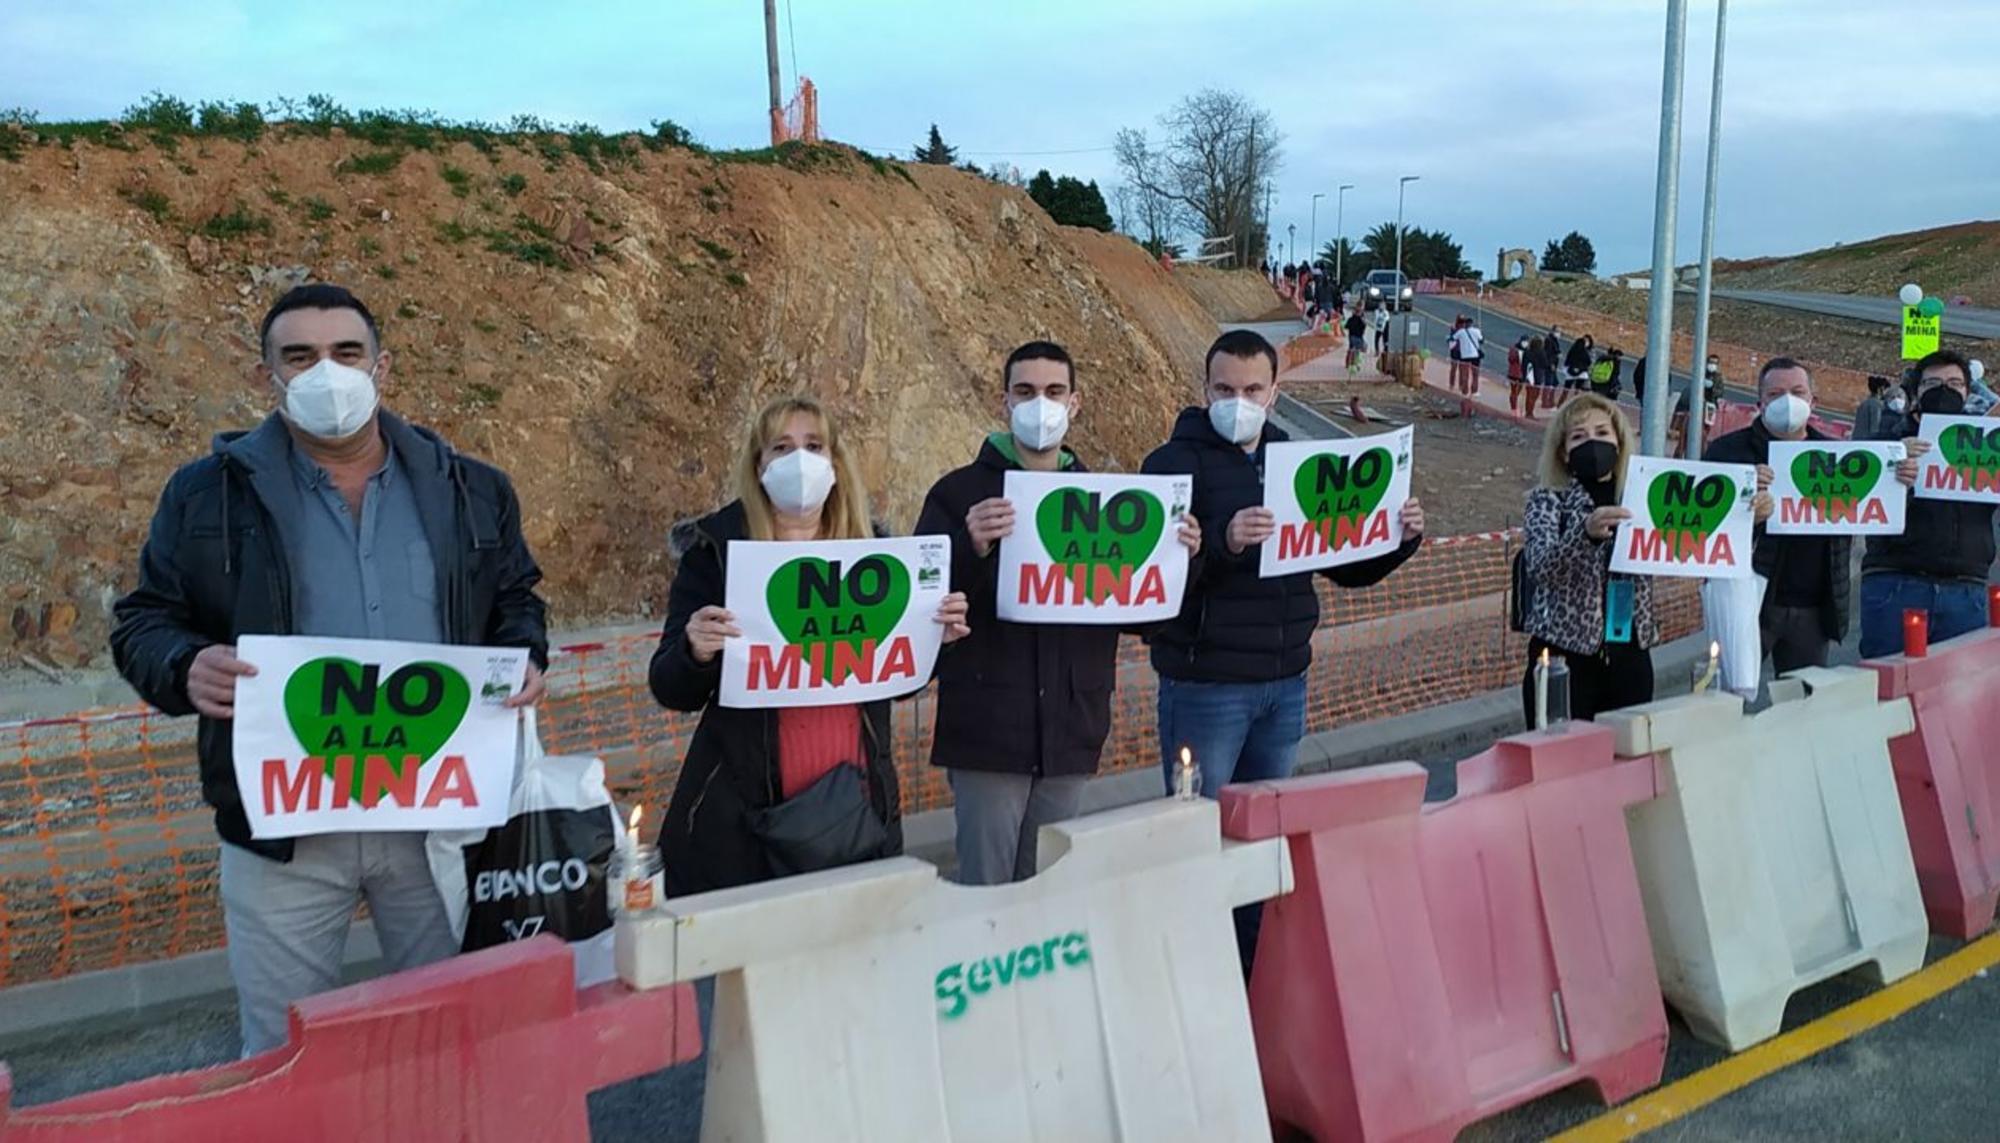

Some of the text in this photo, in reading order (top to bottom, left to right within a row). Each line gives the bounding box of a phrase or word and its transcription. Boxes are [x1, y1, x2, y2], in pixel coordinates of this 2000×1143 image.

[1905, 325, 1936, 336] MINA
[1956, 425, 2000, 453] NO
[1315, 450, 1382, 495] NO
[1808, 450, 1869, 479] NO
[1925, 464, 2000, 494] MIN
[1663, 474, 1725, 508] NO
[1811, 482, 1852, 495] A LA
[1061, 491, 1148, 535] NO
[1316, 494, 1361, 516] A LA
[1663, 511, 1703, 527] A LA
[1781, 496, 1889, 525] MINA
[1065, 541, 1124, 559] A LA
[1278, 508, 1390, 561] MINA
[1628, 527, 1736, 566] MINA
[797, 558, 892, 609] NO
[1018, 563, 1167, 607] MINA
[800, 614, 867, 637] A LA
[746, 636, 916, 690] MINA
[321, 661, 445, 717] NO
[323, 725, 408, 749] A LA
[262, 753, 480, 816] MINA
[935, 931, 1090, 1020] gevora
